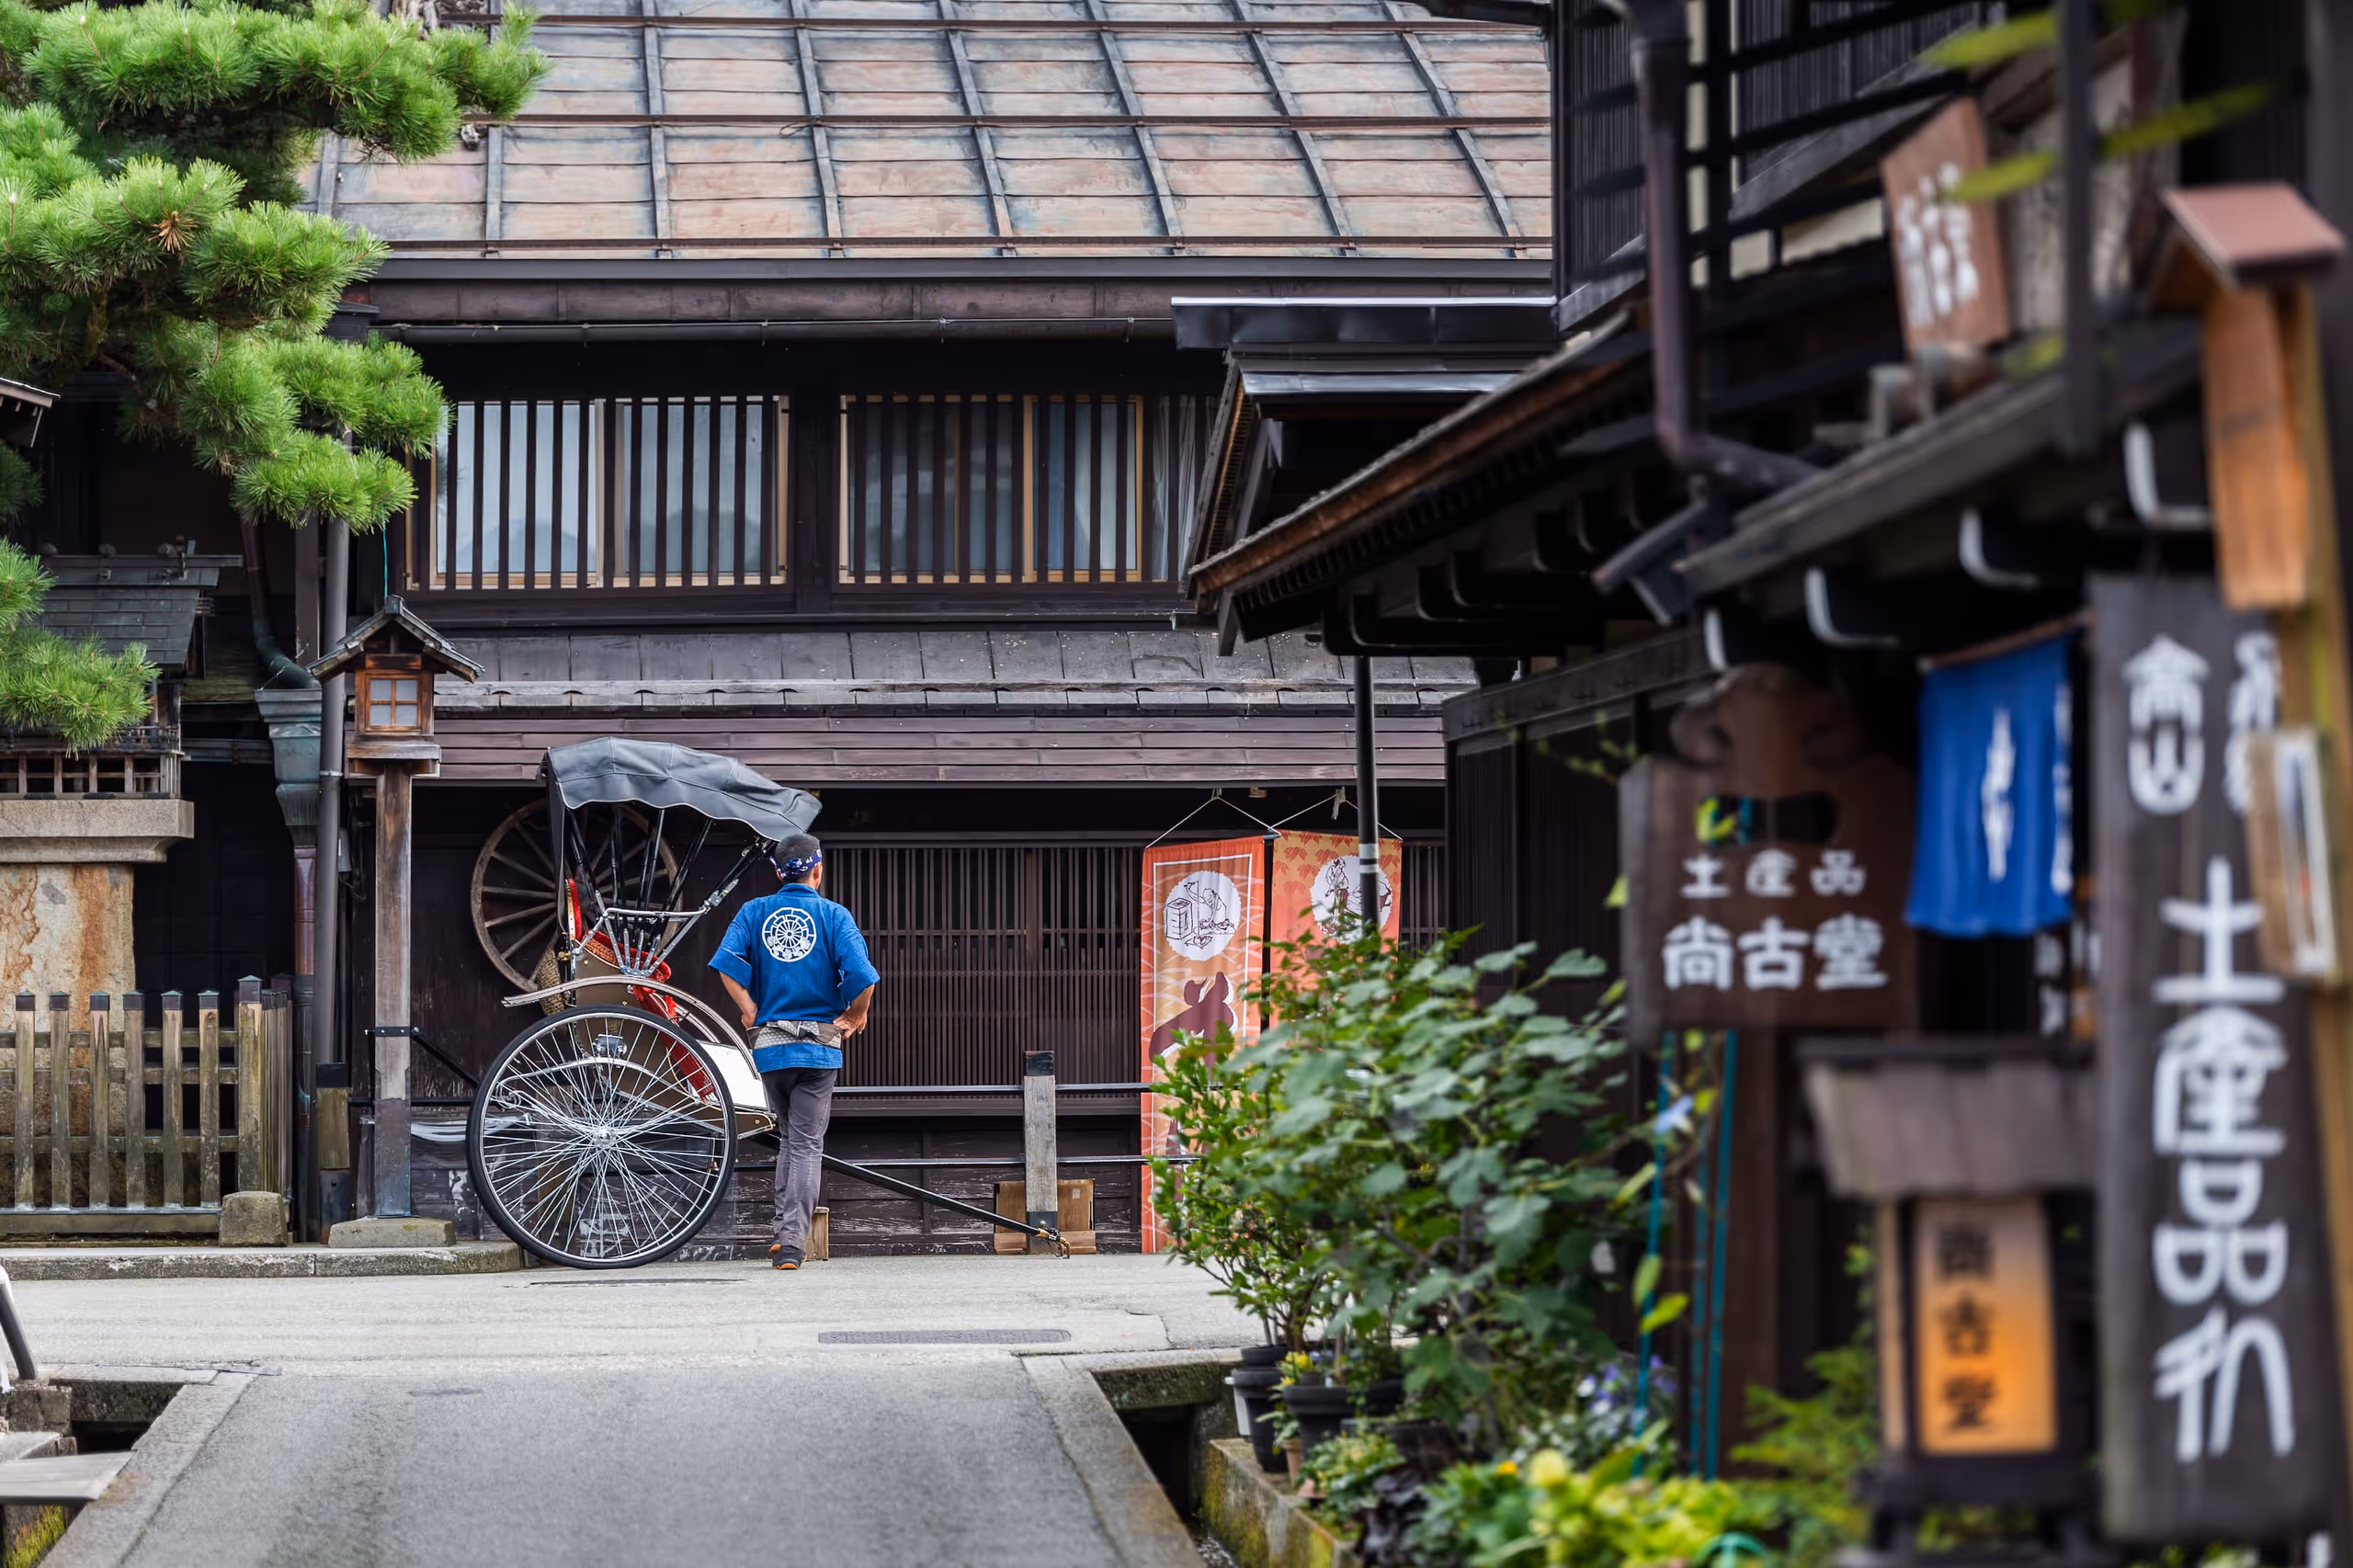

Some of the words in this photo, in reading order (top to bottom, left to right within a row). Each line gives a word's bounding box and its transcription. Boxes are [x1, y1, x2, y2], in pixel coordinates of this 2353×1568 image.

[1680, 847, 1867, 899] 土産品
[1661, 913, 1888, 992] 尚古堂
